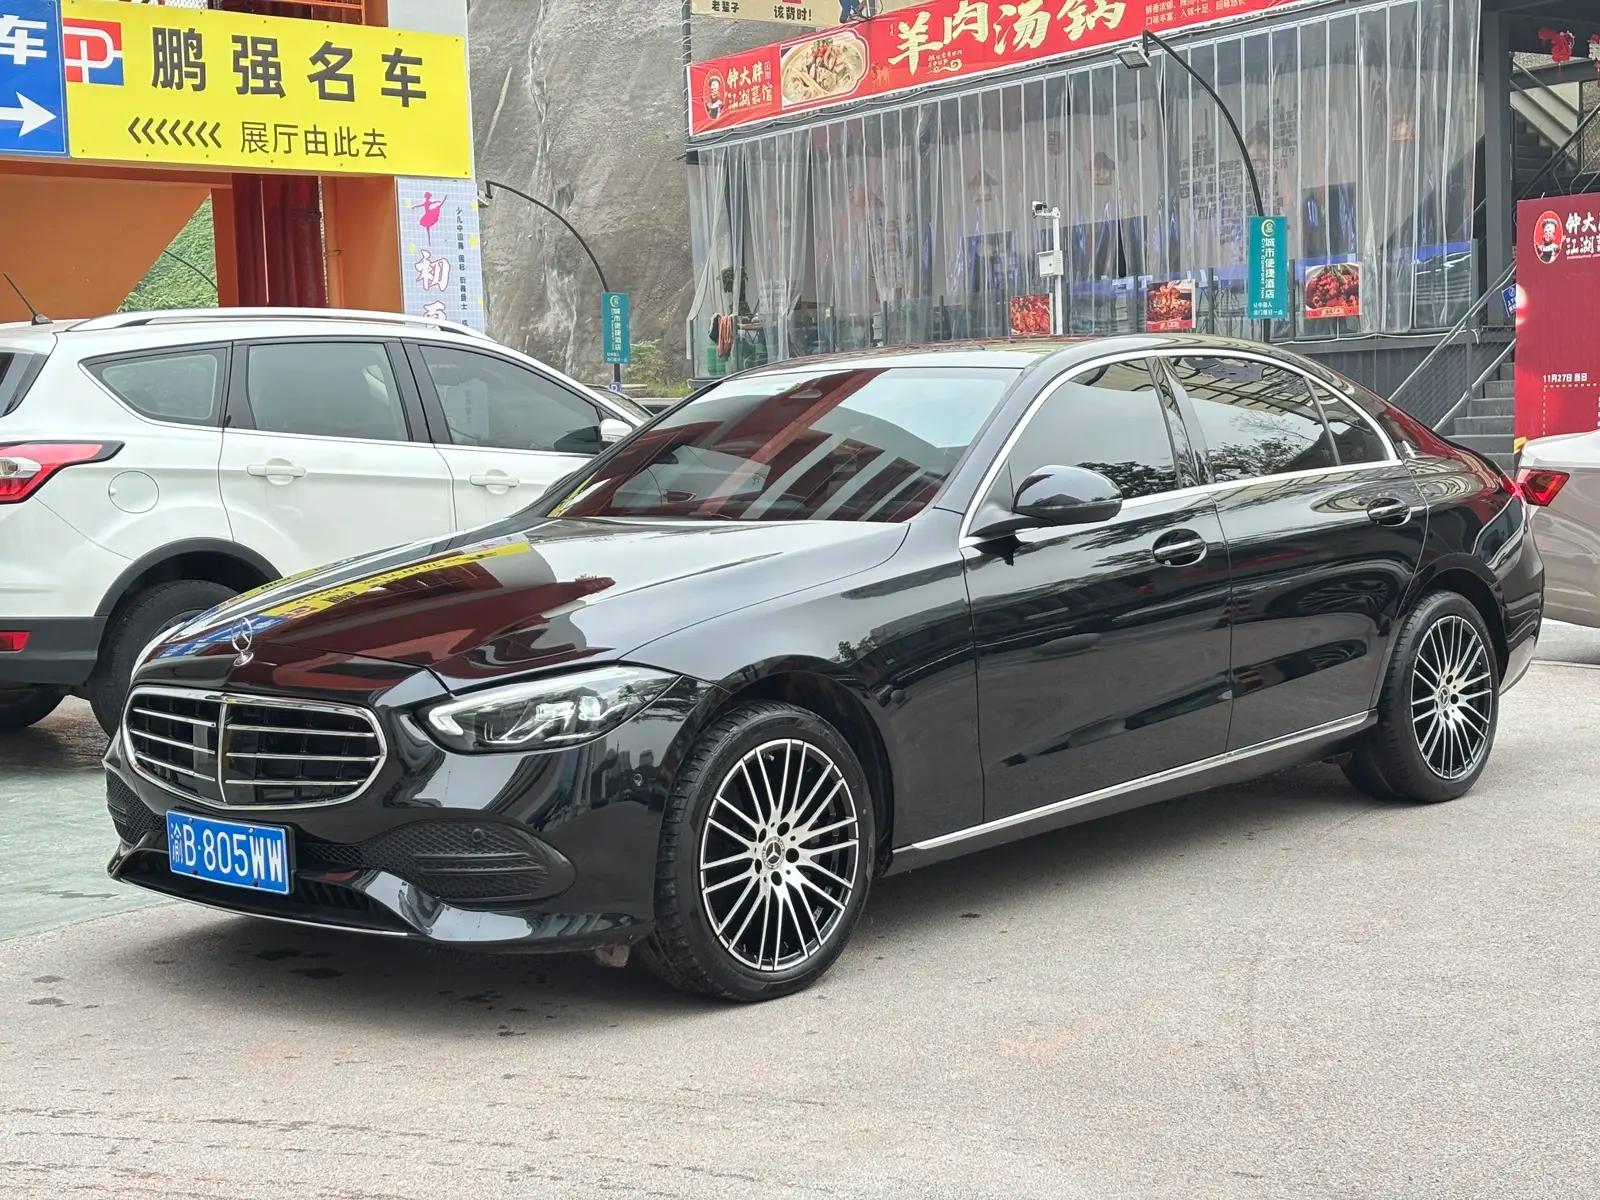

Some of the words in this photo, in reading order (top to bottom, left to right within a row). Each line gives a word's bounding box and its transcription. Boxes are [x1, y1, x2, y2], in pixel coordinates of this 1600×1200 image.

[0, 14, 47, 65] 车
[888, 0, 1126, 75] 羊肉汤锅
[928, 49, 962, 62] Mutton
[151, 27, 427, 108] 鹏强名车
[728, 82, 773, 110] 江湖菜馆
[240, 121, 388, 160] 展厅由此去
[1566, 211, 1600, 235] 钟大
[1265, 237, 1275, 299] 城市便捷酒店
[1543, 373, 1573, 383] 11月27日
